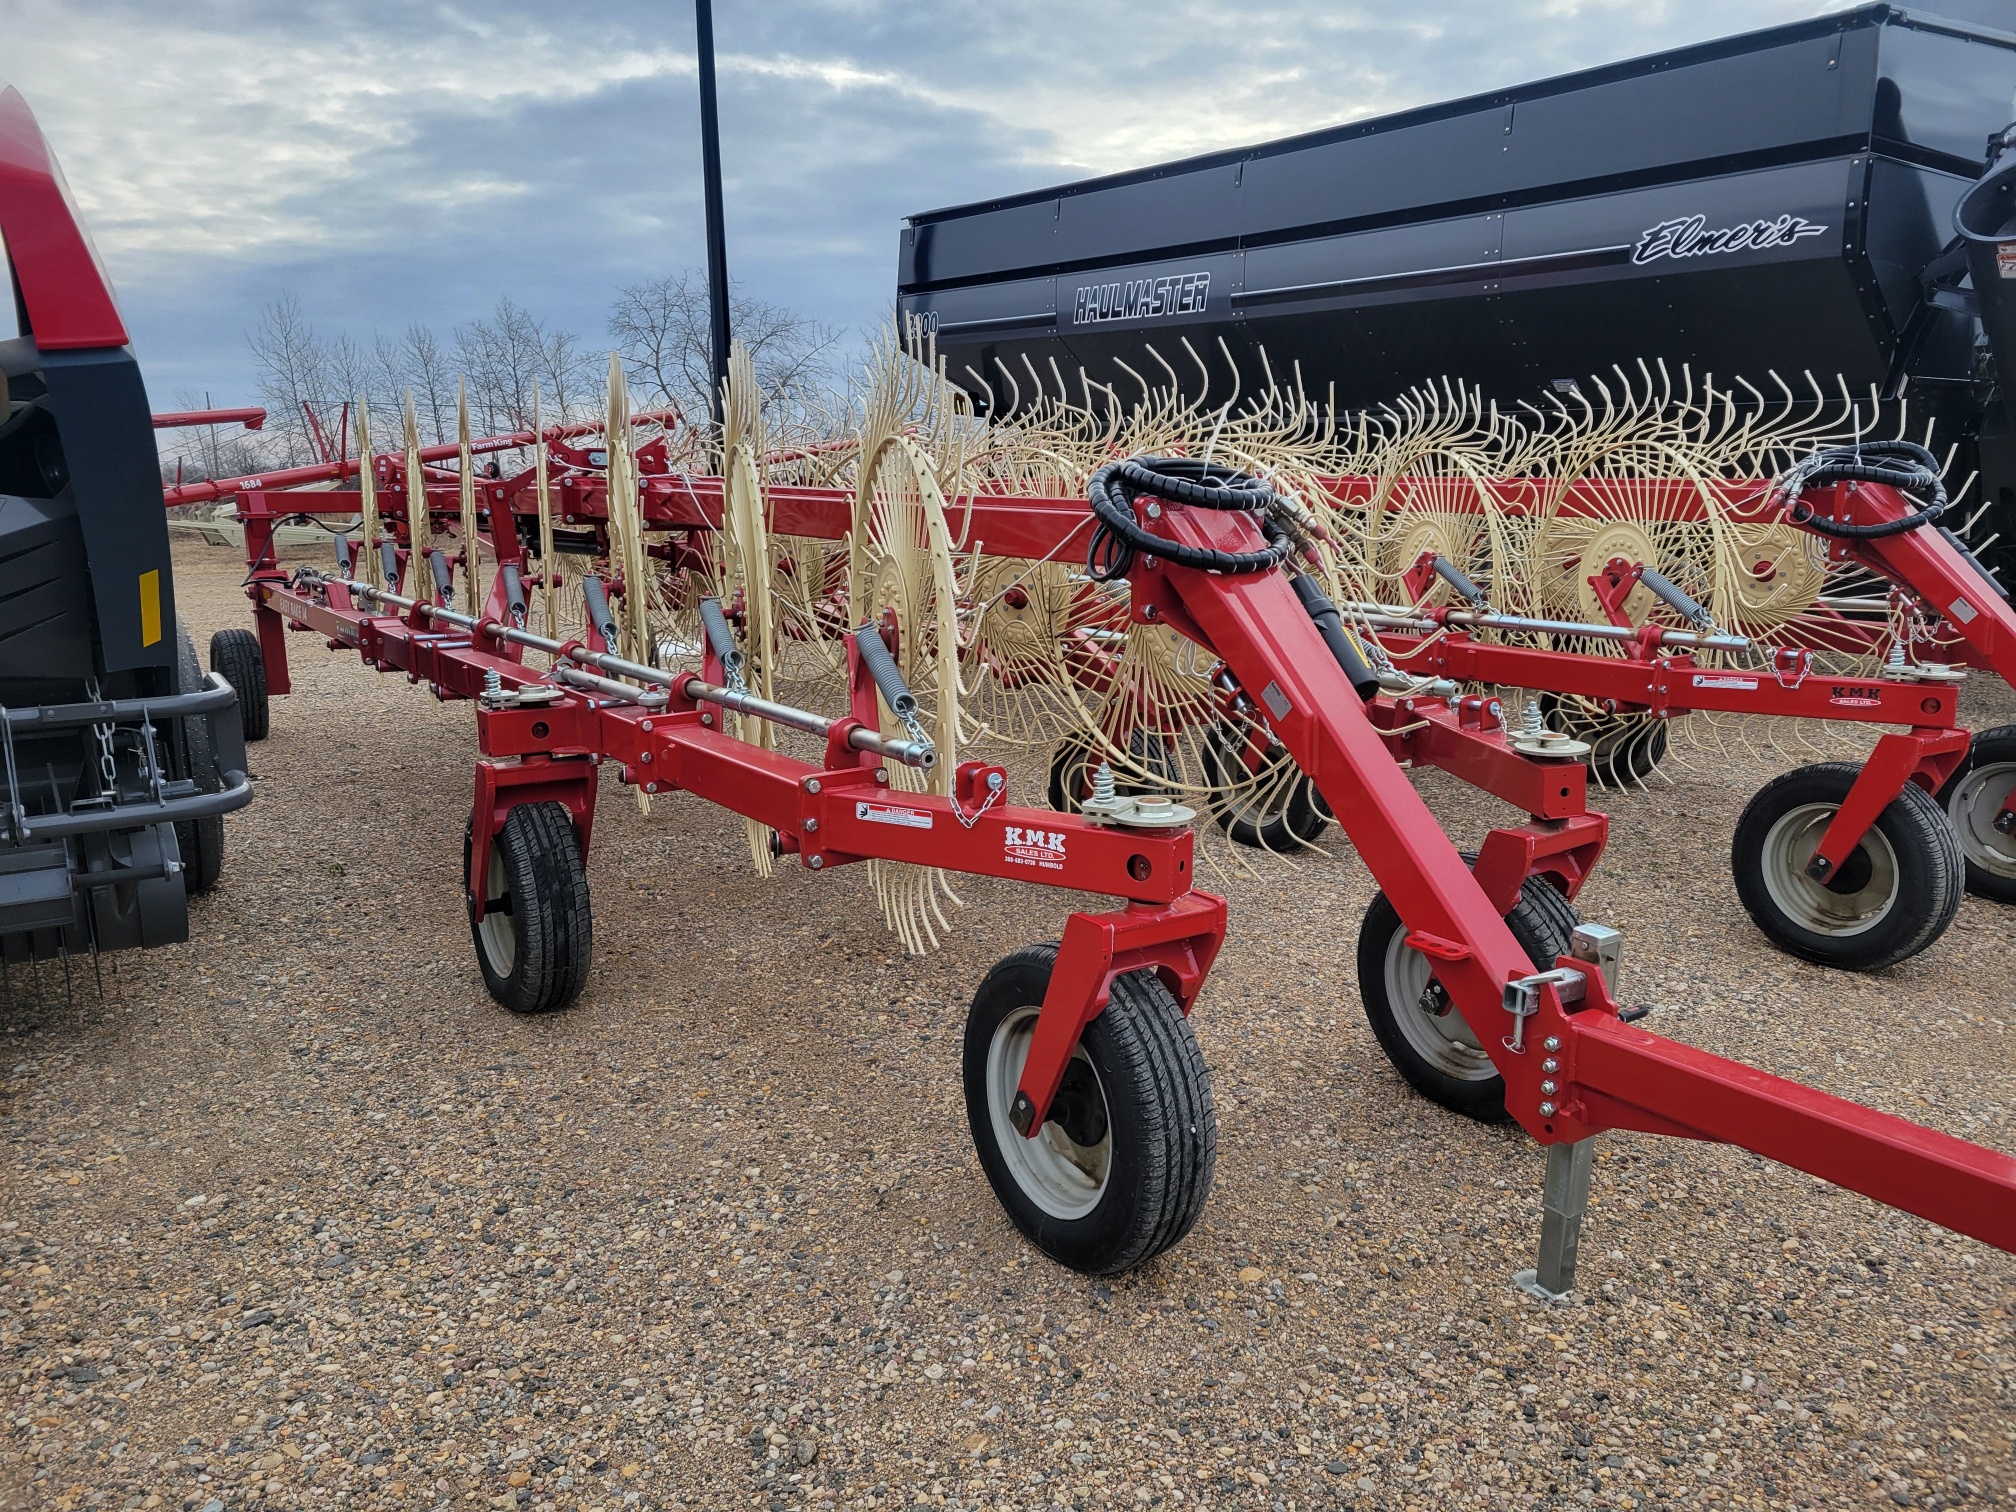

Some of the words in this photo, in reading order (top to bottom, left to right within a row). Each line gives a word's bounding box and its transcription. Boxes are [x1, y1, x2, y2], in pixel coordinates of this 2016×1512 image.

[1632, 214, 1829, 265] Elmer's
[1073, 271, 1211, 325] HAULMASTER
[239, 479, 262, 490] 1684
[279, 597, 290, 614] EASY
[290, 602, 302, 620] RAKE
[891, 807, 915, 816] DANGER
[1015, 848, 1039, 857] SALES
[1040, 851, 1055, 859] LTD.
